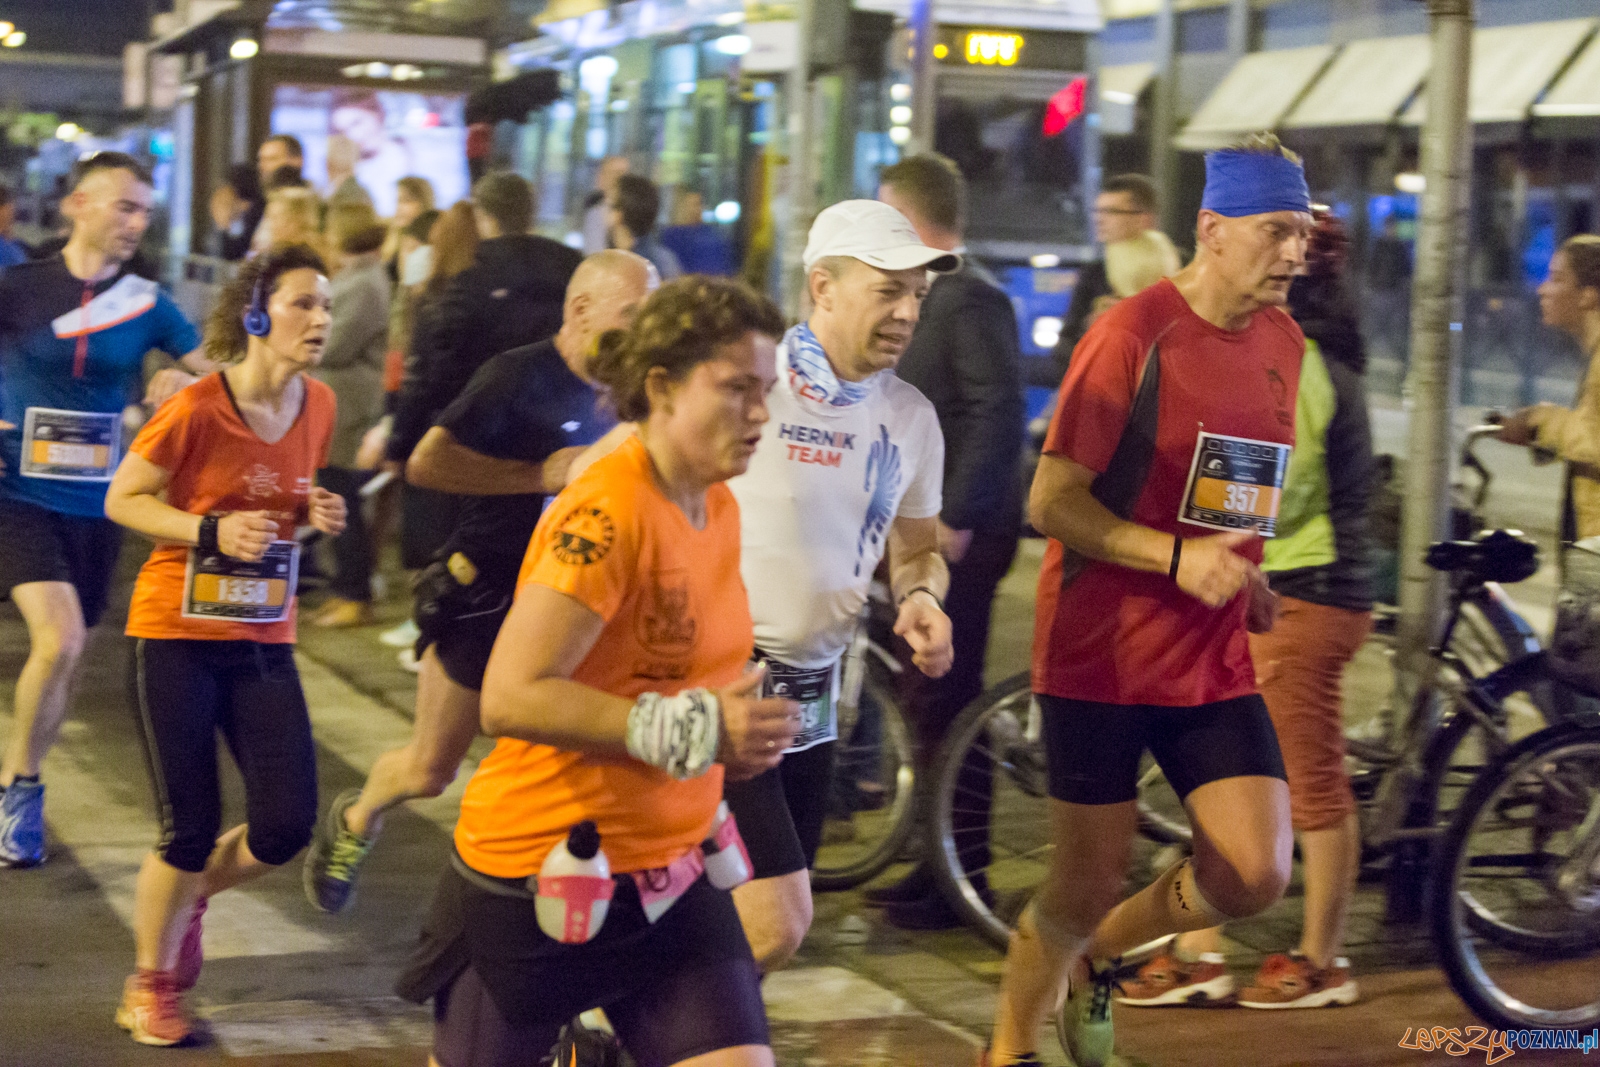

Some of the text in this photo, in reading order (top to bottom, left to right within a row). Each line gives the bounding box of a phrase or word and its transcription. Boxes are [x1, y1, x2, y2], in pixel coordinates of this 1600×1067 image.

[779, 423, 857, 450] HERNIK
[787, 444, 843, 468] TEAM
[1223, 484, 1259, 513] 357
